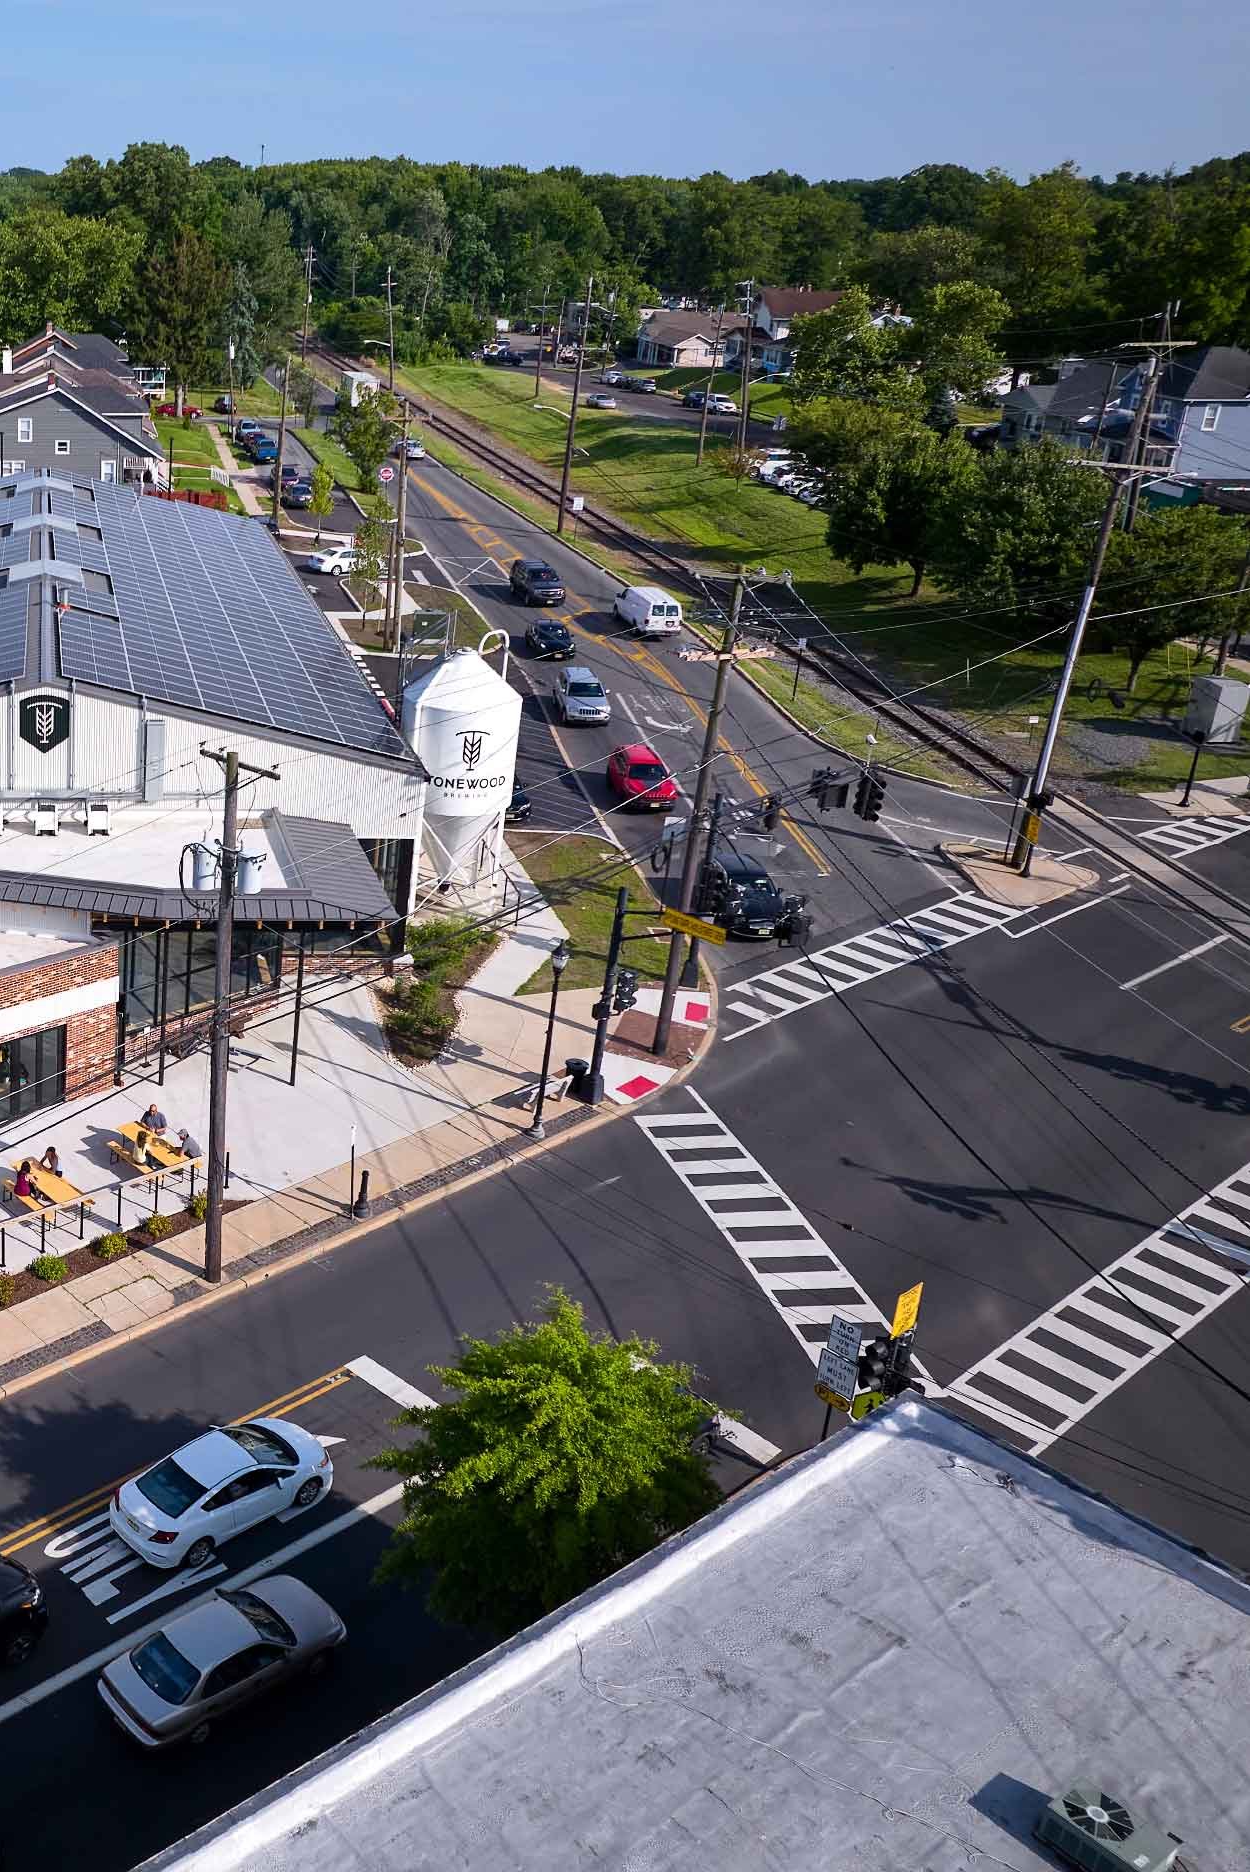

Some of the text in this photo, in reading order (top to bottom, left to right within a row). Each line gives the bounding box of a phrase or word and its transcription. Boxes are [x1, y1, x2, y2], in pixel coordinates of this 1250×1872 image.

[839, 1321, 854, 1334] NO
[836, 1329, 856, 1343] TURN
[838, 1339, 850, 1348] ON
[835, 1345, 849, 1356] RED
[823, 1353, 838, 1366] LEFT
[826, 1367, 847, 1382] MUST
[819, 1373, 851, 1395] TURN LEFT
